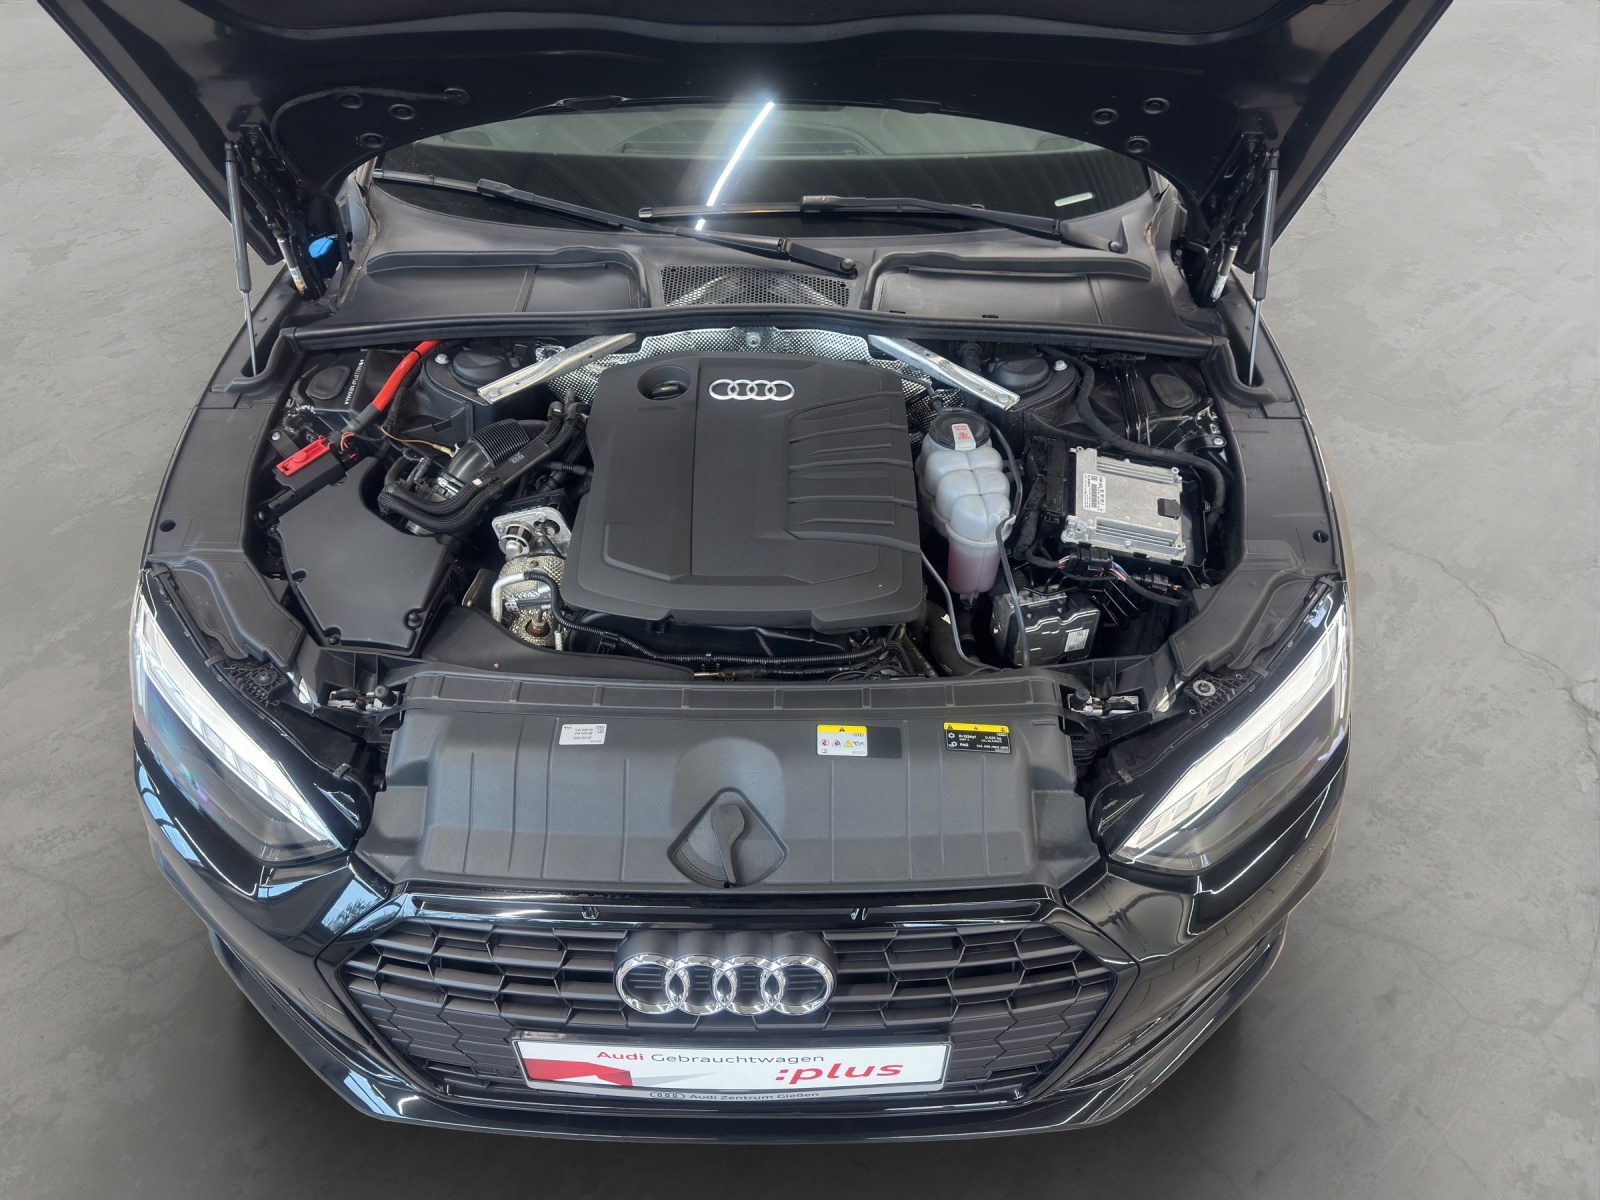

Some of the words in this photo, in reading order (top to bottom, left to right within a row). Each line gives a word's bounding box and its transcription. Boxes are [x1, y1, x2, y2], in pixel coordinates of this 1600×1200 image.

[596, 1051, 644, 1061] Audi
[651, 1053, 824, 1064] Gebrauchtwagen
[775, 1063, 904, 1084] :plus
